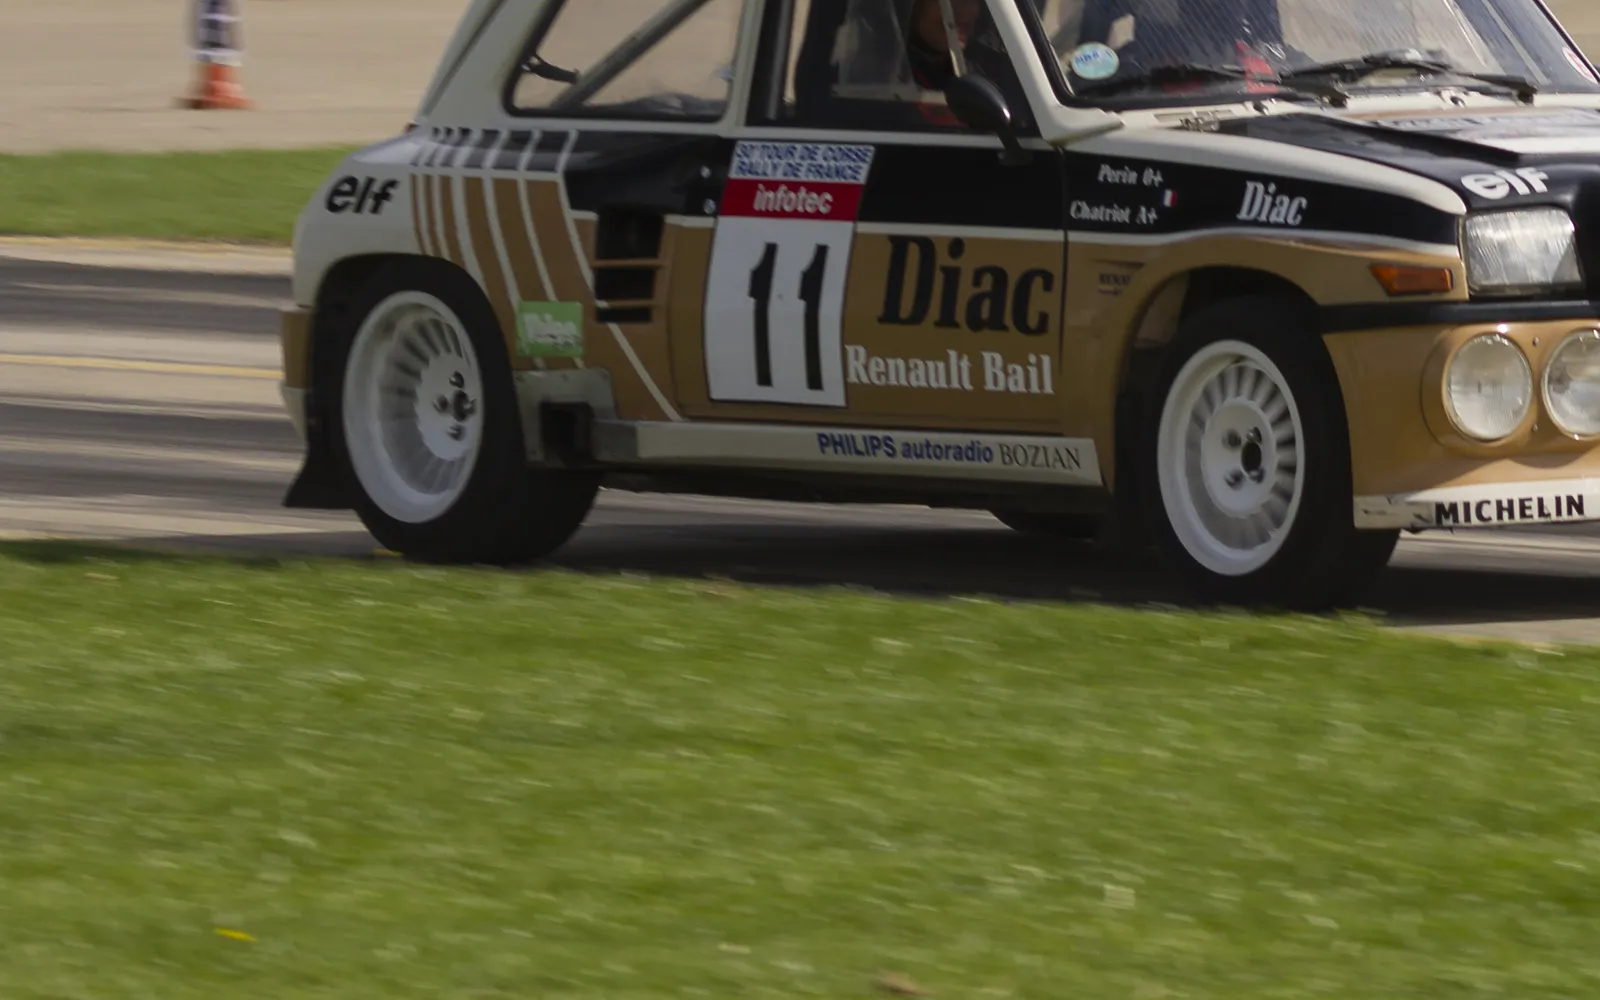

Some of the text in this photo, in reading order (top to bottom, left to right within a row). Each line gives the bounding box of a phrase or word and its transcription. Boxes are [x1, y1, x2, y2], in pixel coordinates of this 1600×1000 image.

[737, 159, 863, 181] RALLY DE FRANCE
[760, 144, 798, 161] TOUR
[799, 145, 821, 162] DE
[822, 146, 873, 165] CORSE
[324, 175, 401, 215] elf
[752, 182, 834, 215] infotec
[1460, 167, 1550, 200] elf
[1236, 180, 1308, 226] Diac
[876, 235, 1055, 336] Diac
[748, 242, 830, 391] 11
[845, 344, 1055, 395] Renault Bail
[816, 432, 994, 464] PHILIPS autoradio
[998, 442, 1082, 470] BOZIAN
[1435, 494, 1585, 525] MICHELIN
